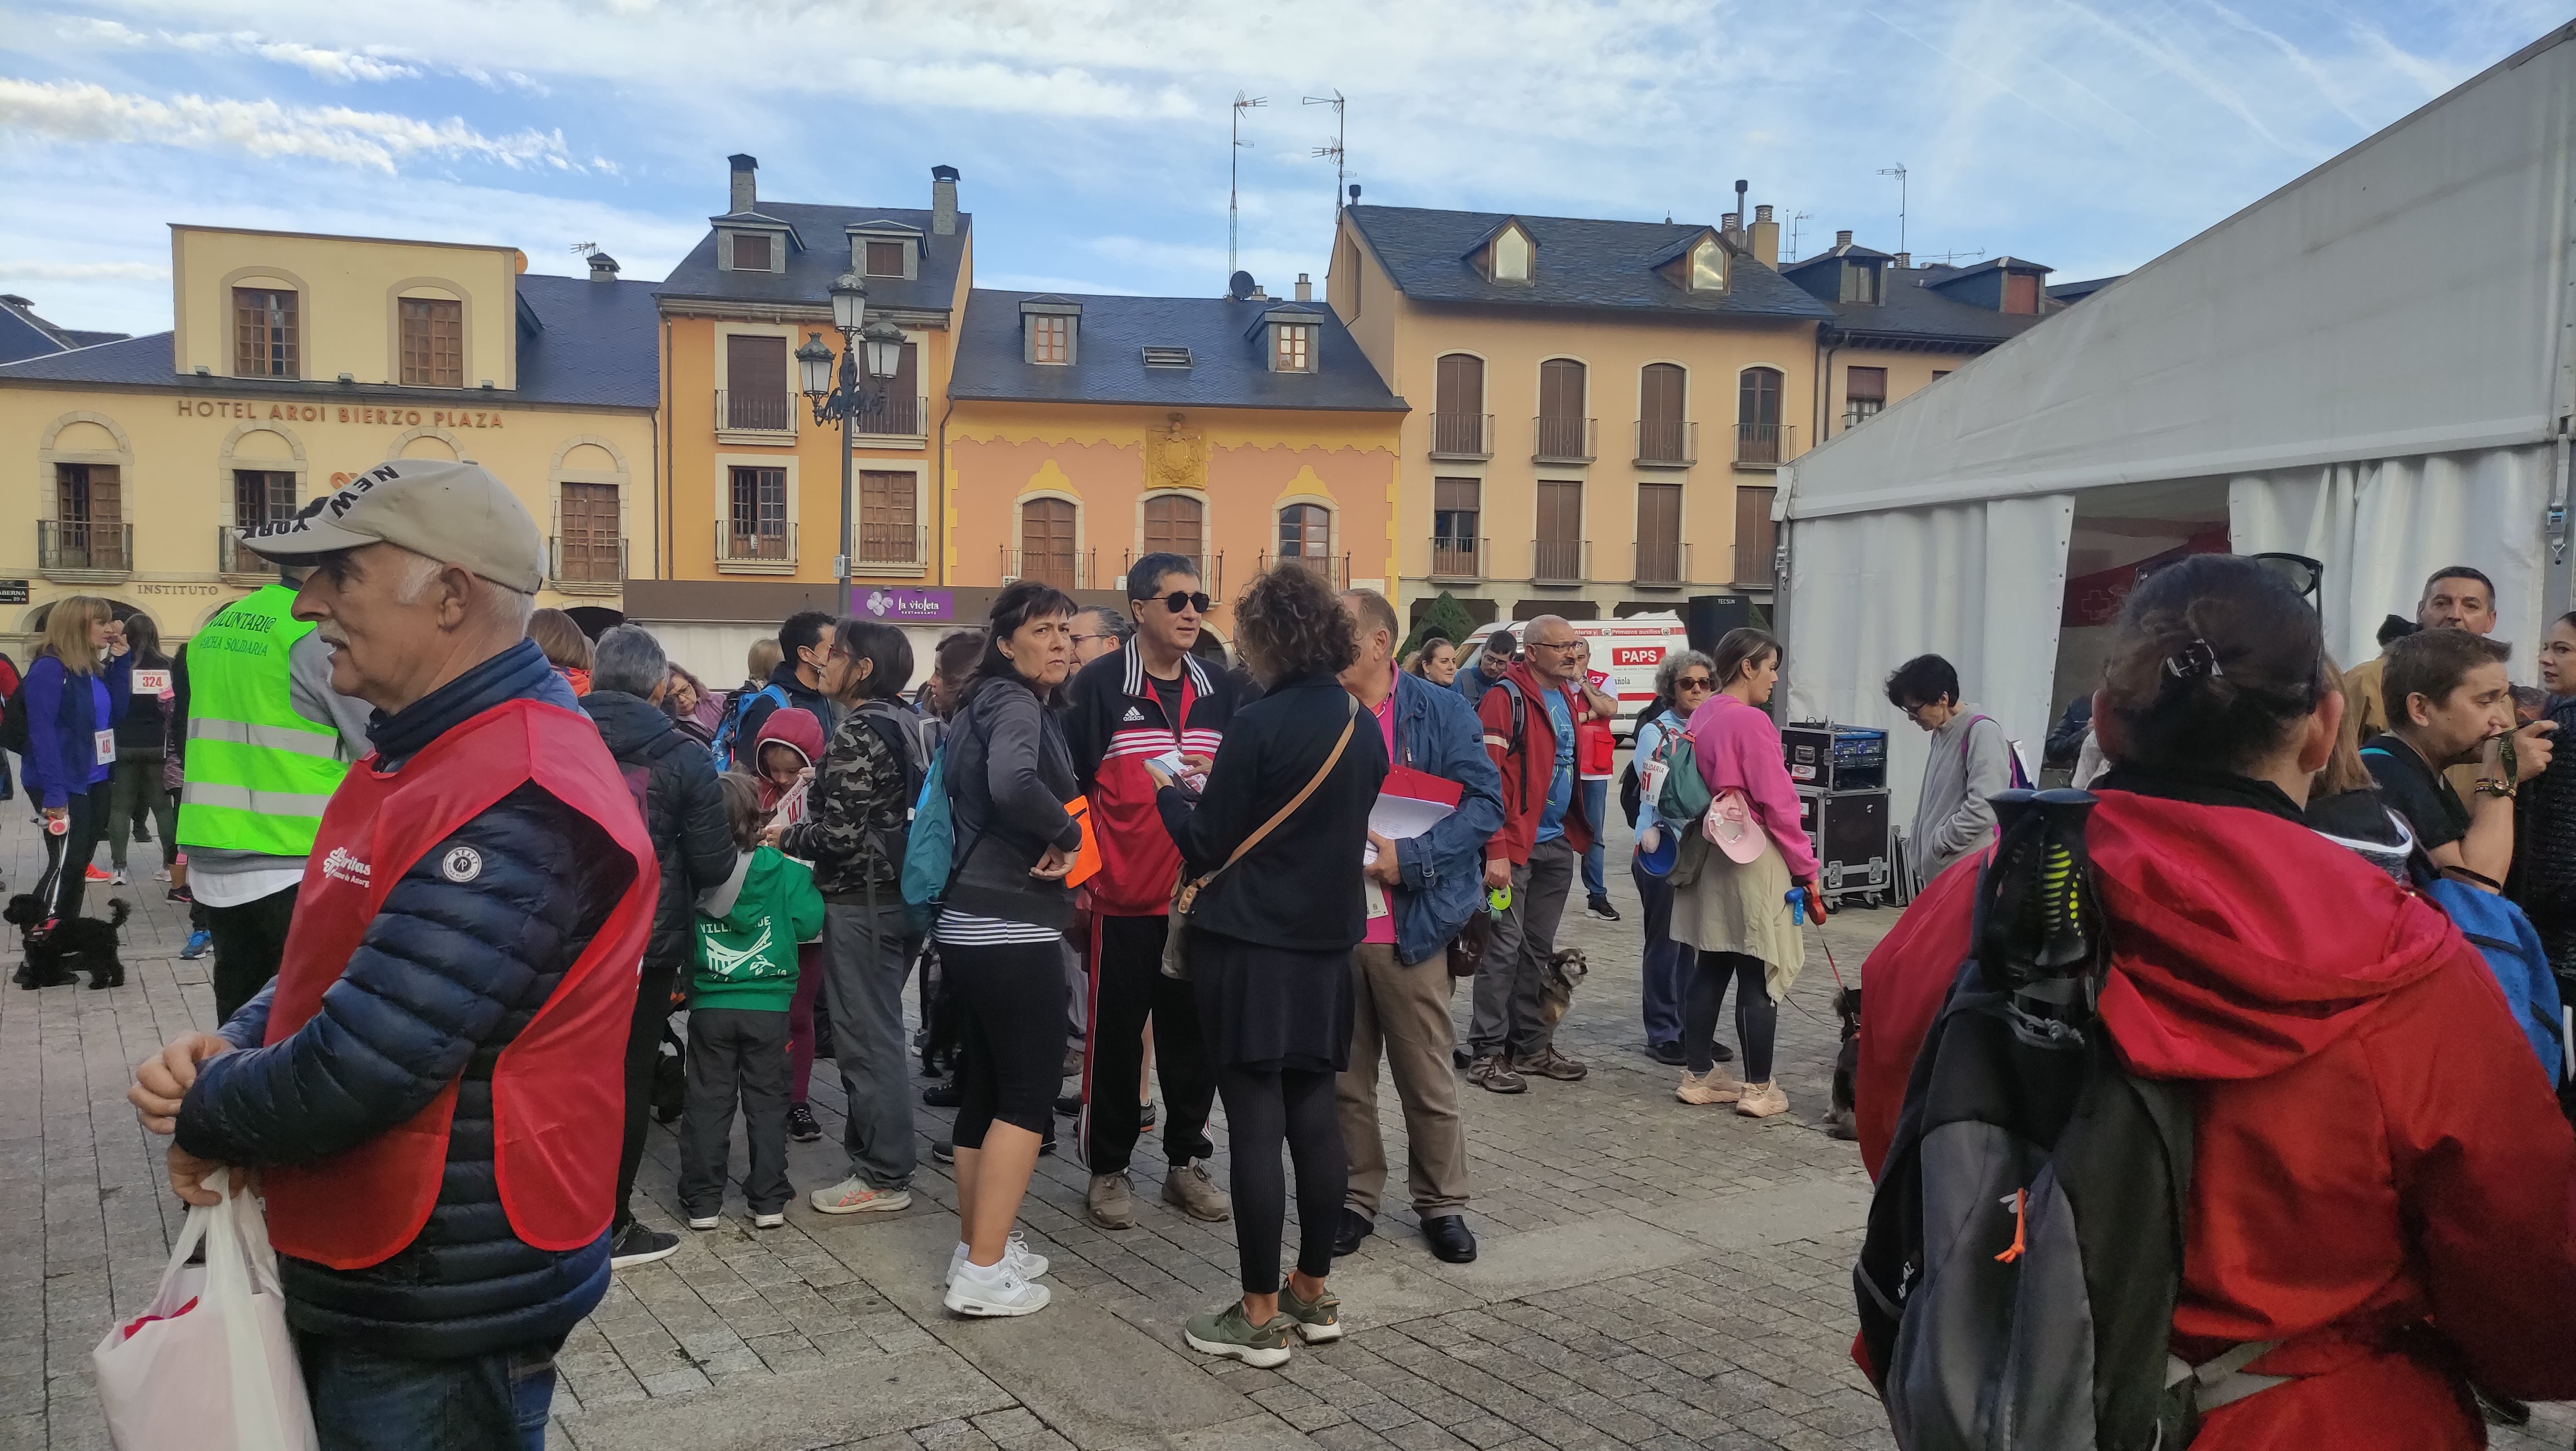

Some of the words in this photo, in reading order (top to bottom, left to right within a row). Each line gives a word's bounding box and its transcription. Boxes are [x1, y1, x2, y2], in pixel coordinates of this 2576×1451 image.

[178, 400, 256, 419] HOTEL
[270, 405, 325, 422] AROI
[338, 407, 422, 426] BIERZO
[434, 411, 504, 428] PLAZA
[330, 465, 401, 519] NEW
[137, 585, 219, 596] INSTITUTO
[898, 596, 906, 611] la
[909, 596, 939, 611] violeta
[1622, 650, 1657, 663] PAPS
[142, 676, 163, 688] 324
[787, 793, 802, 825] 147
